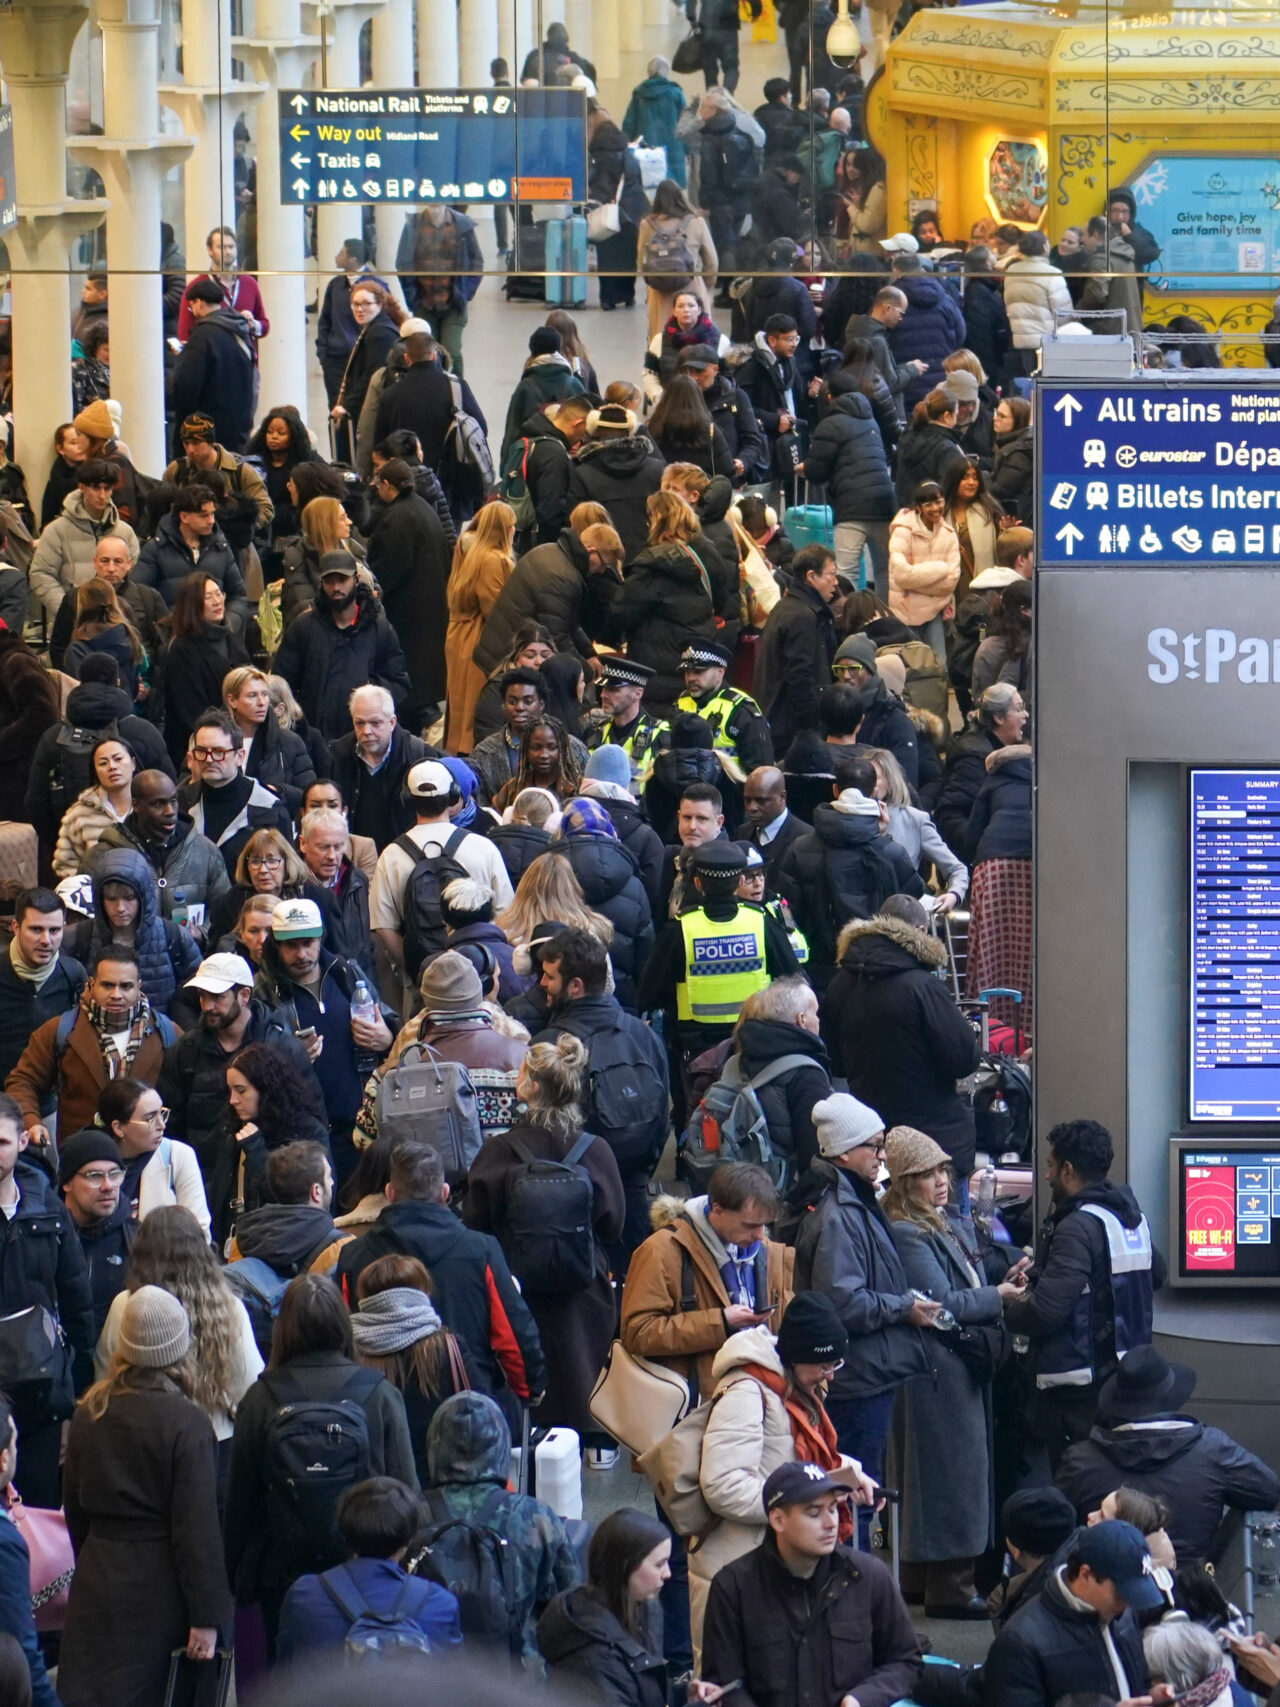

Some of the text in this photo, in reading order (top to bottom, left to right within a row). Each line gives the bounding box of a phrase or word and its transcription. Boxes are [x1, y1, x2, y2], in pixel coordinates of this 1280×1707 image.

[316, 97, 420, 112] National Rail
[425, 95, 469, 104] Tickets and
[425, 104, 464, 113] platforms
[317, 126, 382, 144] Way out
[386, 132, 439, 141] Midland Road
[318, 153, 361, 168] Taxis
[1177, 212, 1257, 224] Give hope, joy
[1172, 225, 1262, 237] and family time
[1098, 399, 1221, 422] All trains
[1231, 409, 1254, 422] and
[1139, 449, 1206, 463] eurostar
[1118, 484, 1202, 509] Billets
[695, 936, 753, 947] BRITISH TRANSPORT
[696, 942, 755, 959] POLICE
[1189, 1230, 1232, 1245] FREE WI-FI
